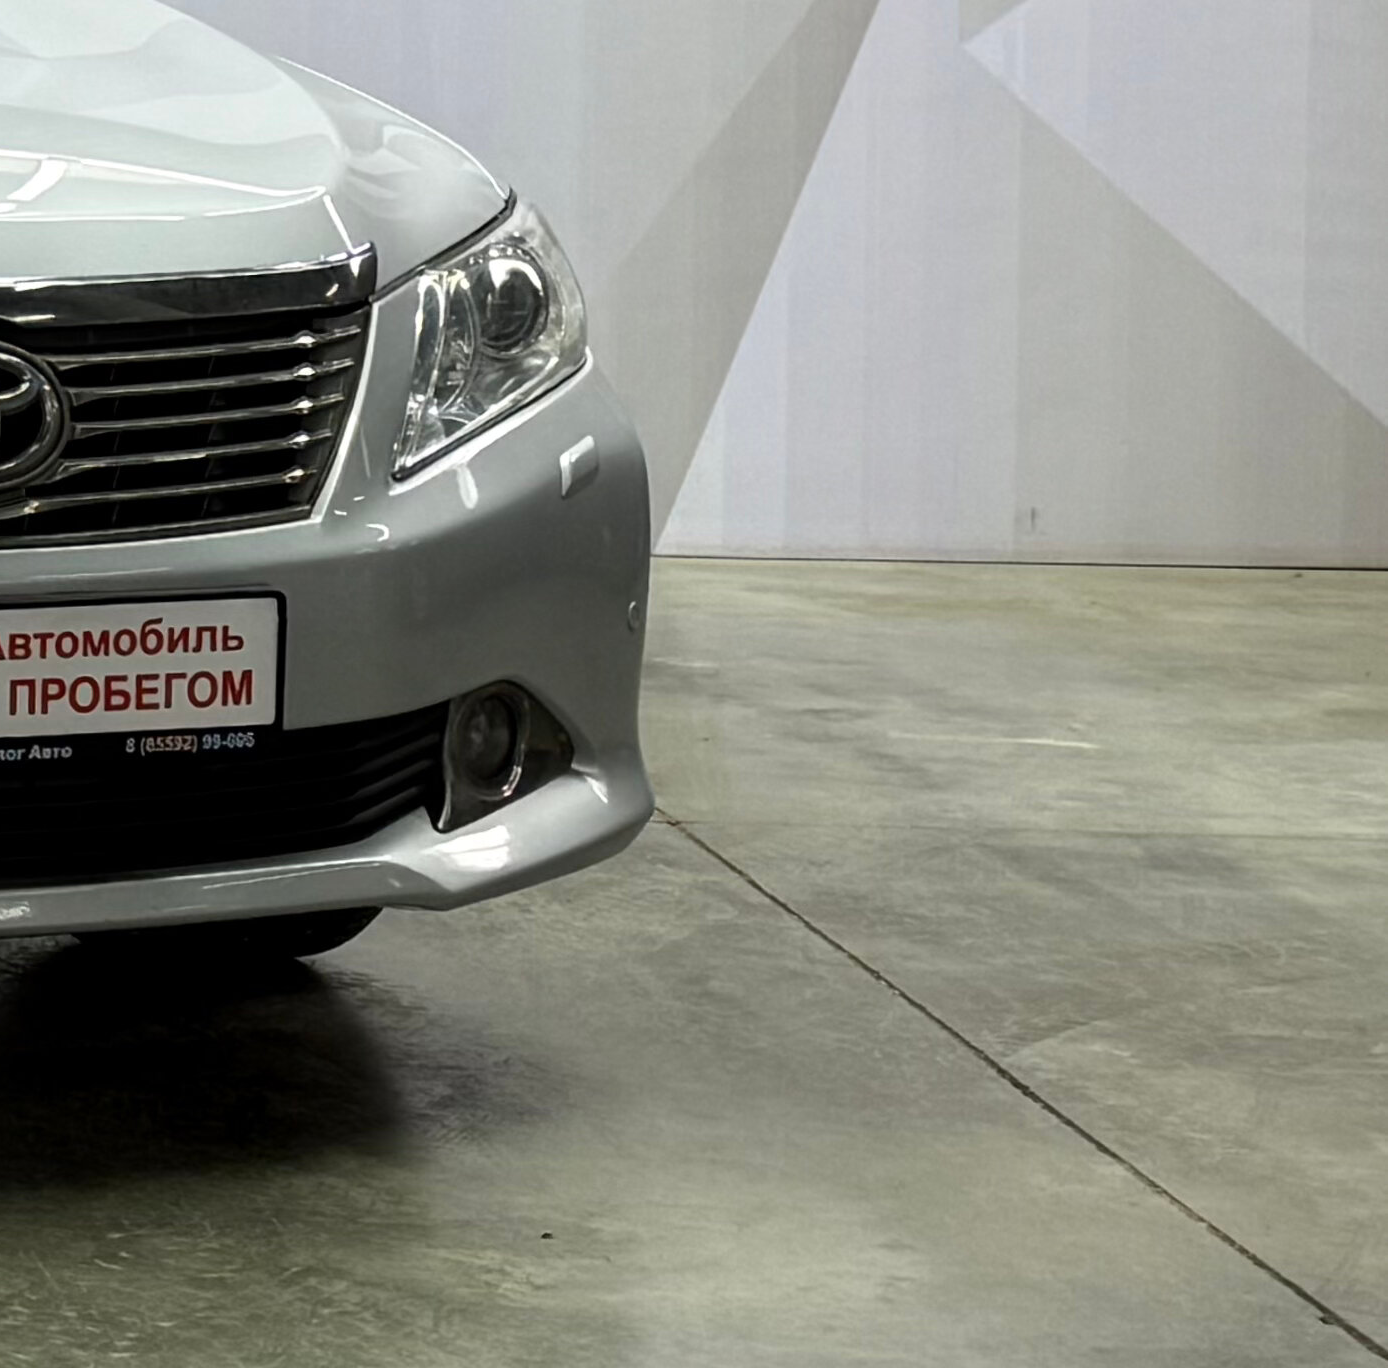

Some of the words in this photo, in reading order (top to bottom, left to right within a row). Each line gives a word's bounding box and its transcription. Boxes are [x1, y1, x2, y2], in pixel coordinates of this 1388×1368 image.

[8, 668, 253, 716] ПРОБЕГОМ
[28, 744, 73, 761] Авто
[125, 737, 136, 753] 8
